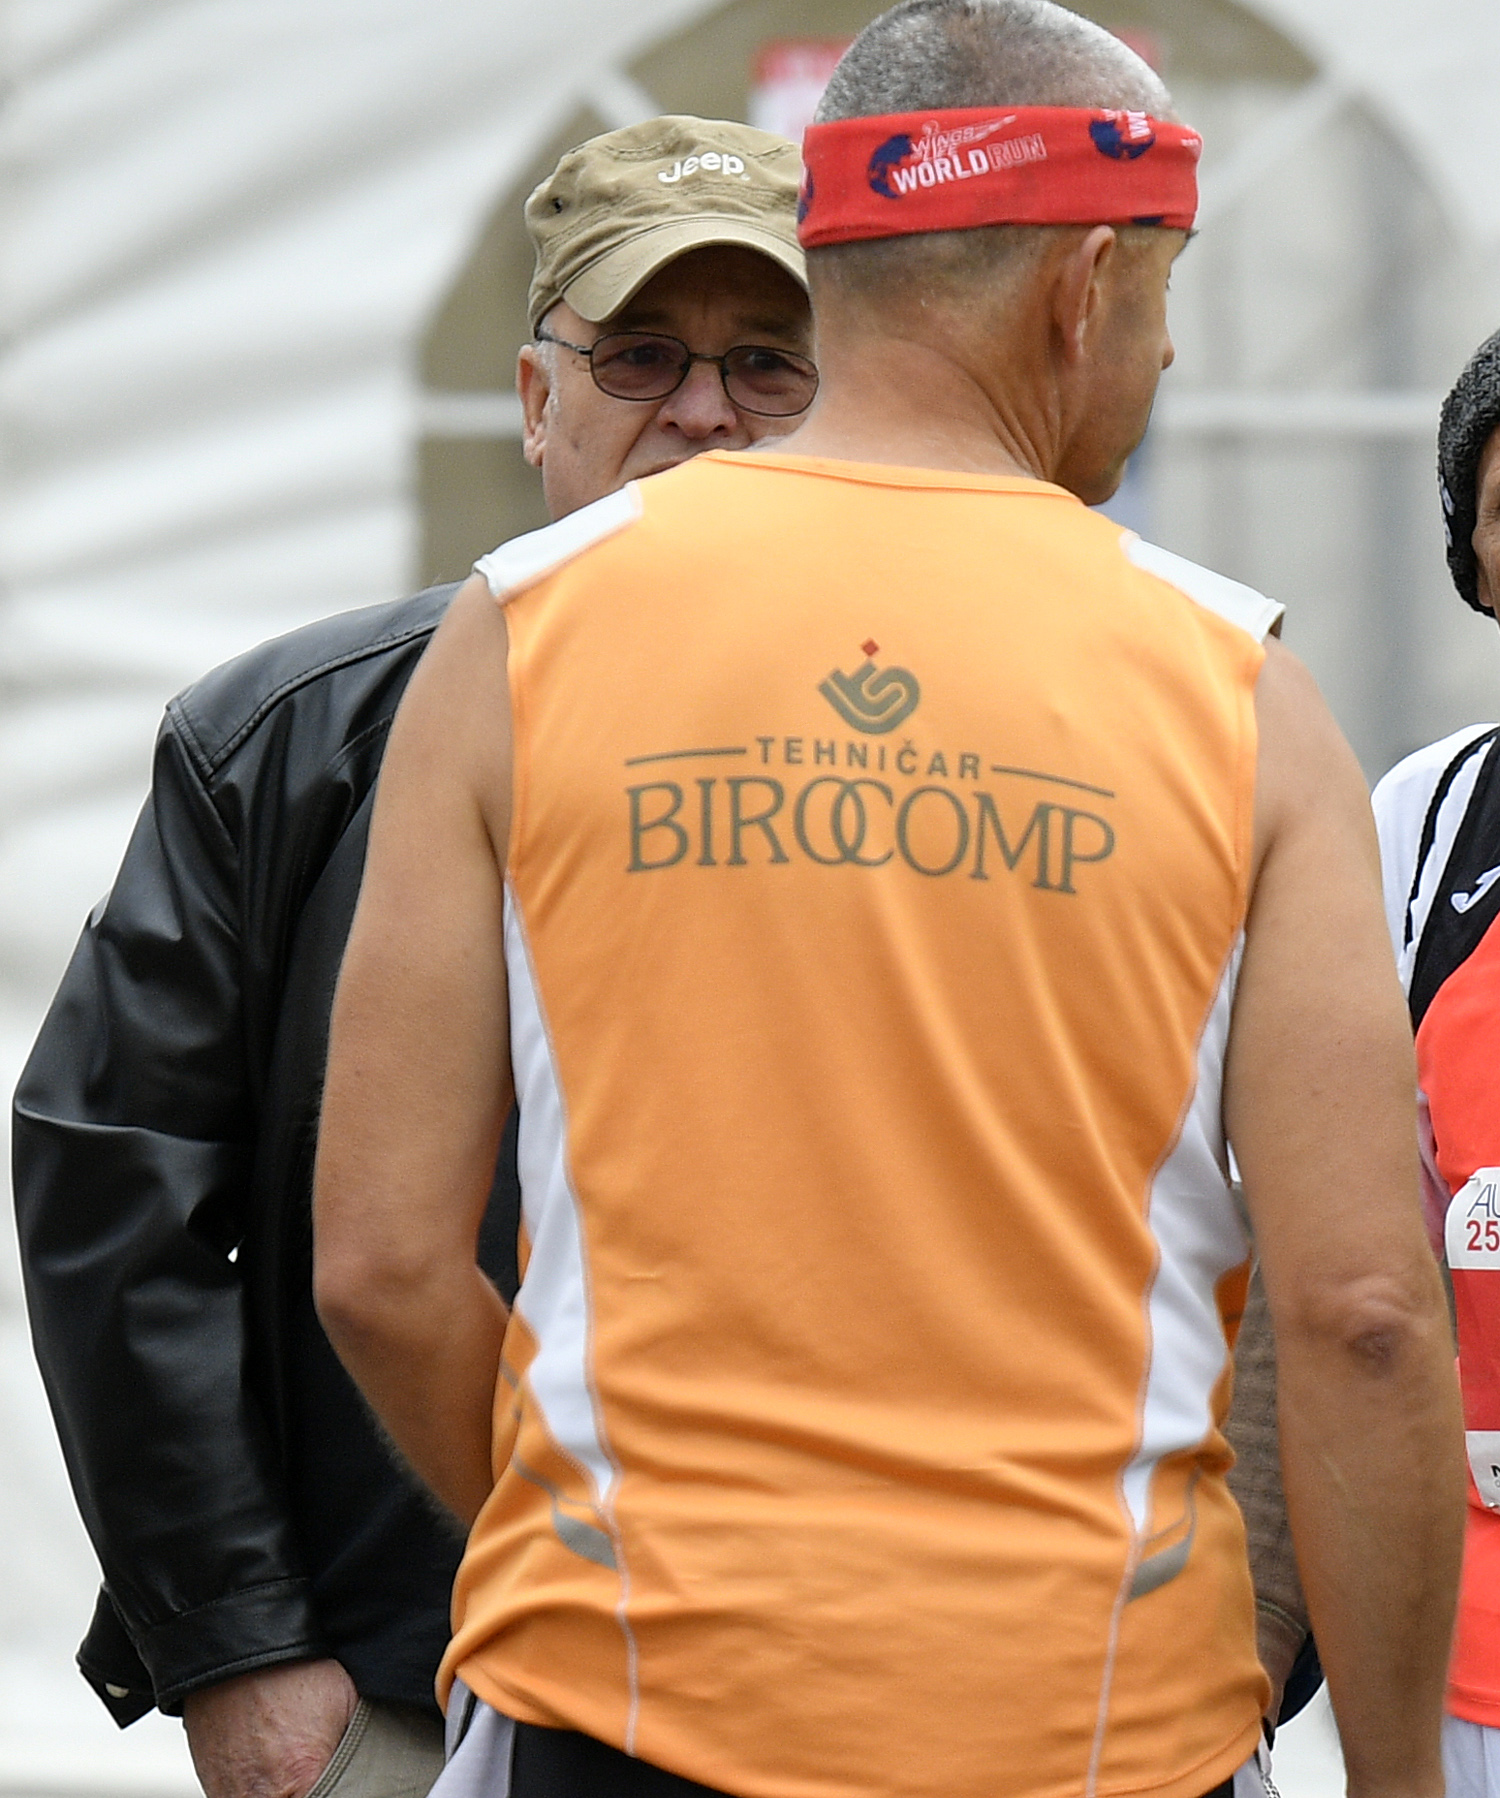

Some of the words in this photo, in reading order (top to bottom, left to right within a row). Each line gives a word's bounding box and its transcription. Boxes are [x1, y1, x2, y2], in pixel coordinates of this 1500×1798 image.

[911, 127, 975, 154] WINGS
[658, 152, 744, 183] Jeep
[892, 149, 990, 194] WORLD
[986, 133, 1047, 171] RUN
[756, 736, 981, 780] TEHNIČAR
[625, 774, 1115, 895] BIROCOMP
